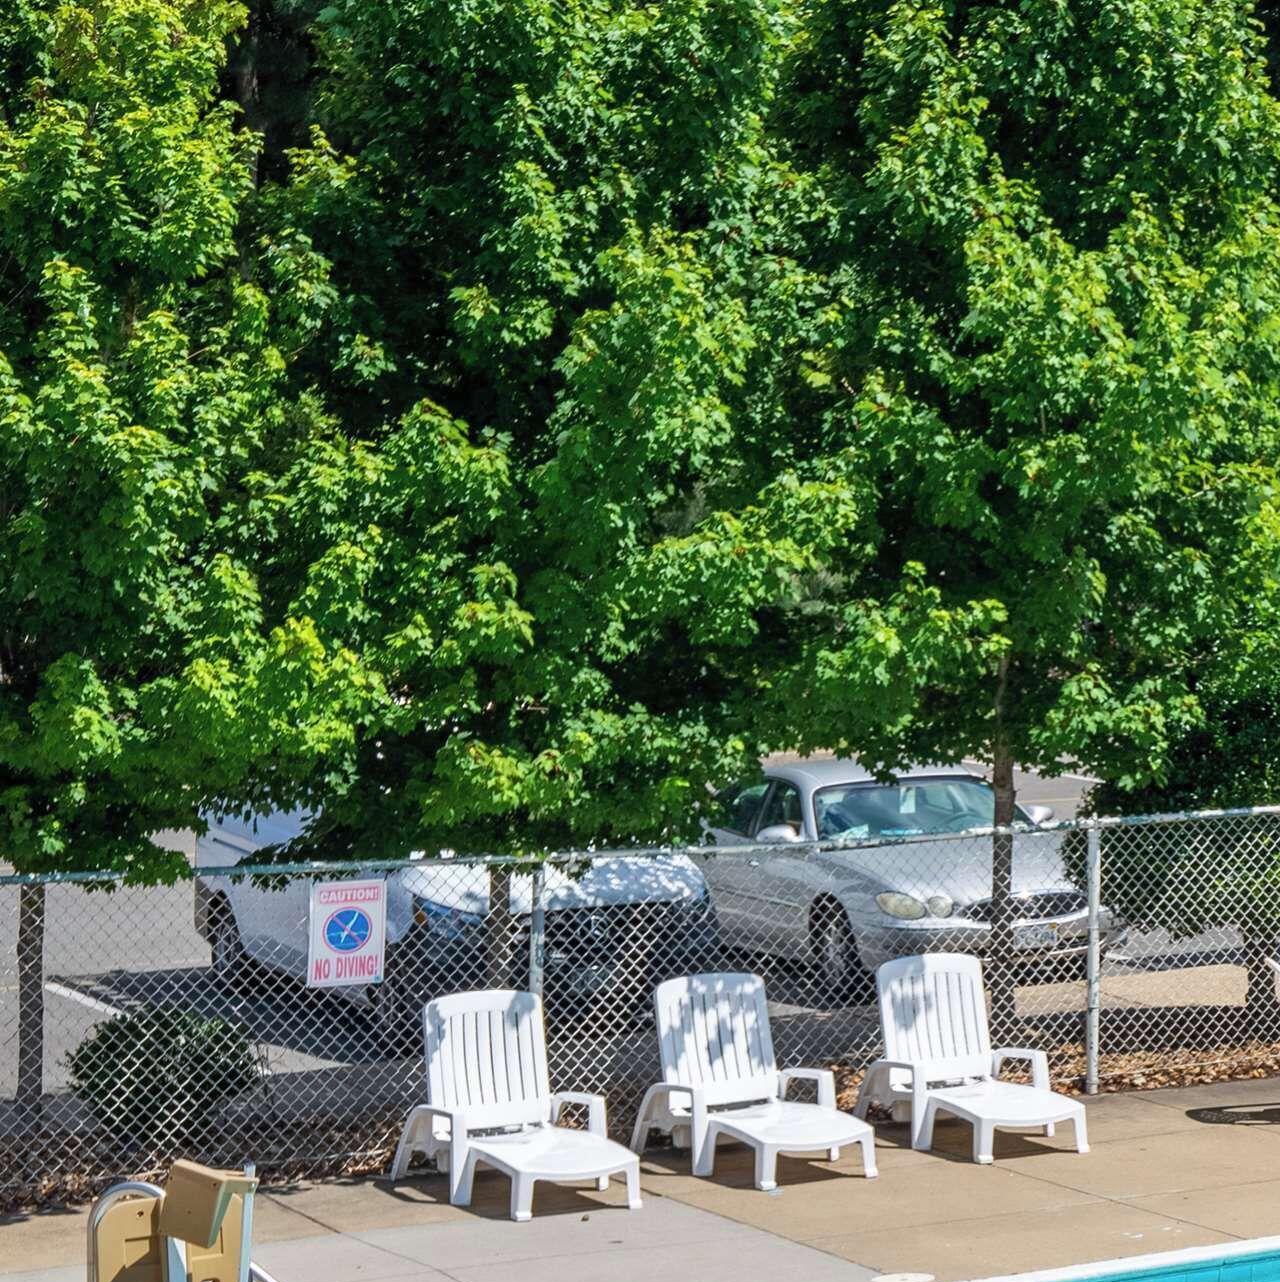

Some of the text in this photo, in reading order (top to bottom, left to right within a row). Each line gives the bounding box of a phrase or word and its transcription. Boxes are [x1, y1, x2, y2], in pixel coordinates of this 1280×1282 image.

[320, 888, 378, 903] CAUTION!
[315, 956, 378, 980] NO DIVING!
